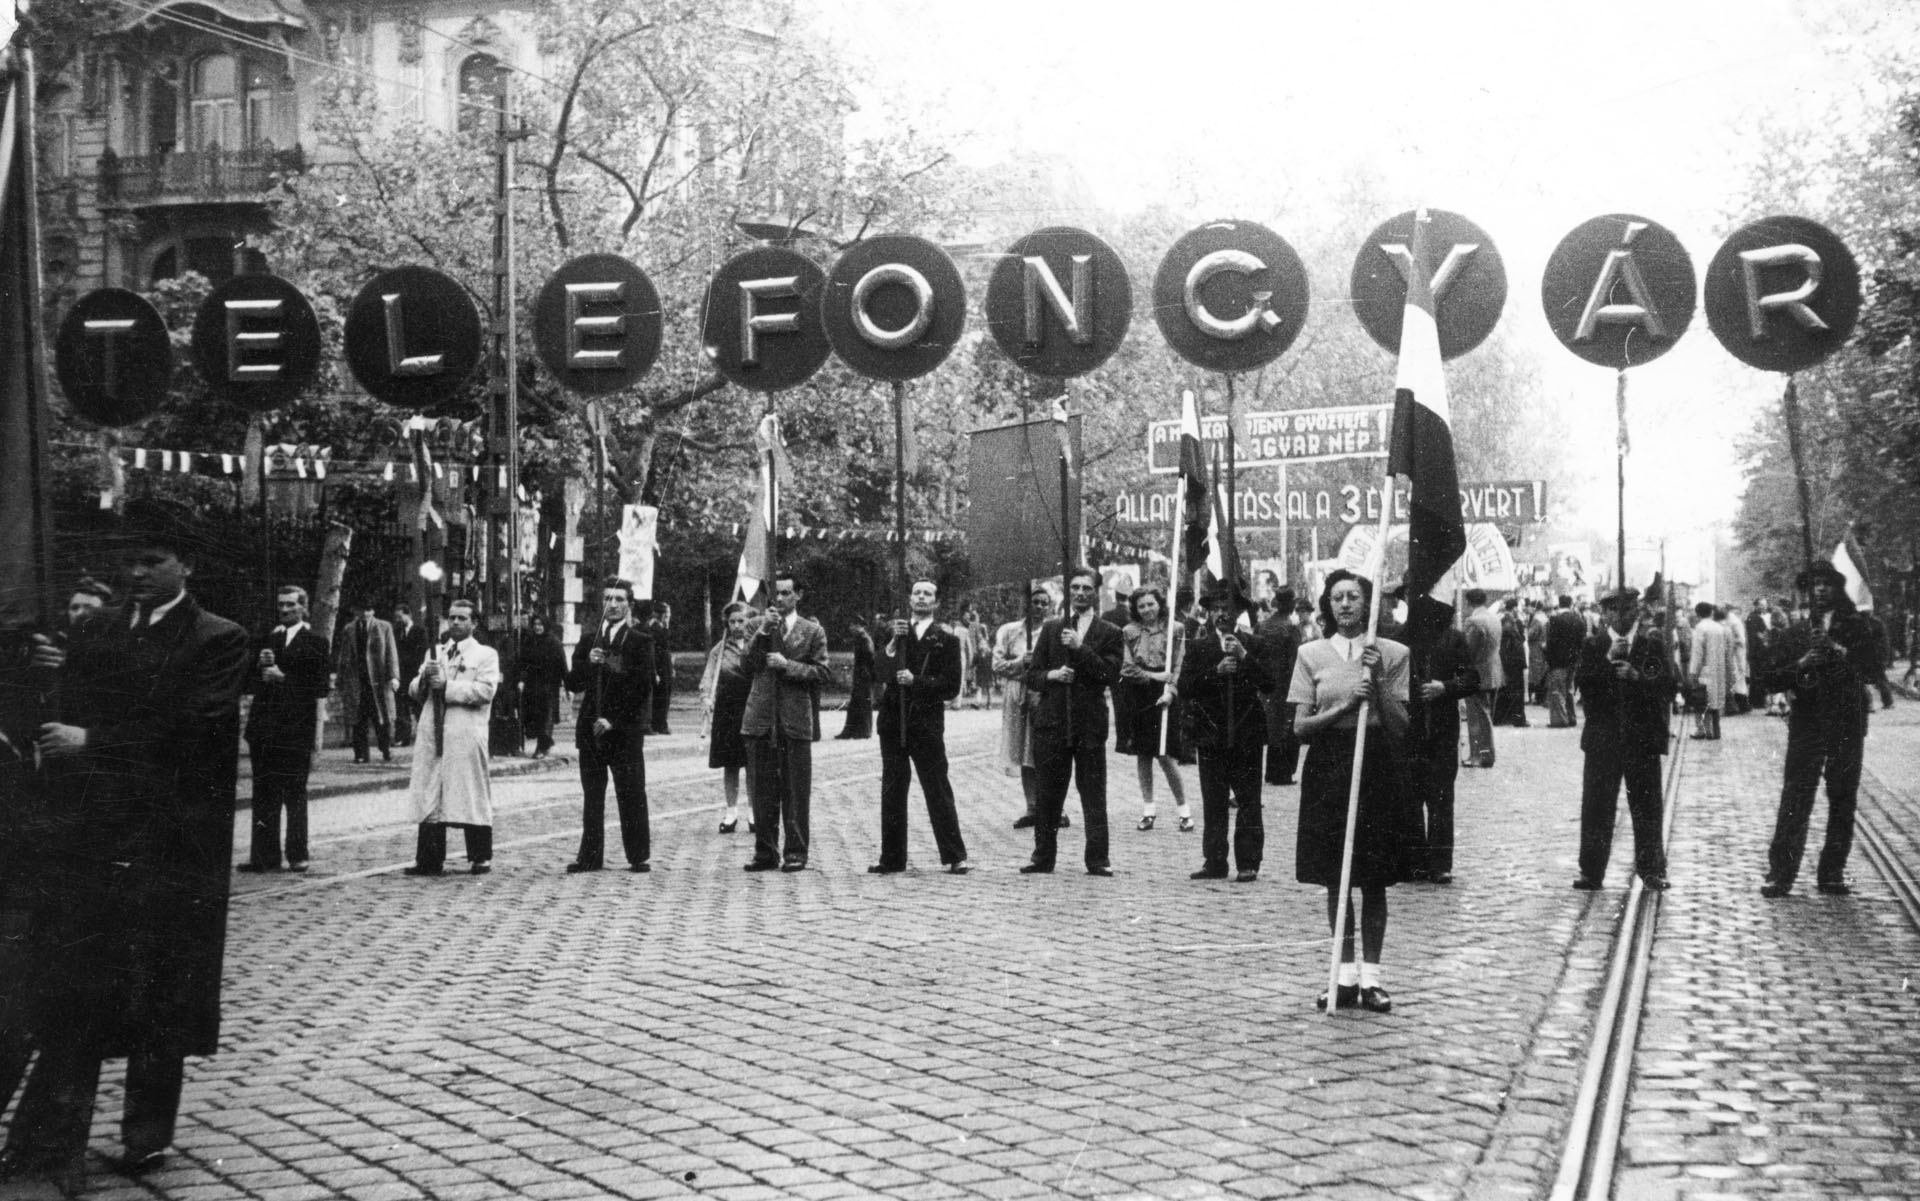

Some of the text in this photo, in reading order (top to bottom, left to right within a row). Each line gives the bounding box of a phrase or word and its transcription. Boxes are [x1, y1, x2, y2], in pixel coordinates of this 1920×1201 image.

[1154, 425, 1167, 443] A
[1316, 490, 1330, 519] A
[1340, 484, 1361, 523] 3
